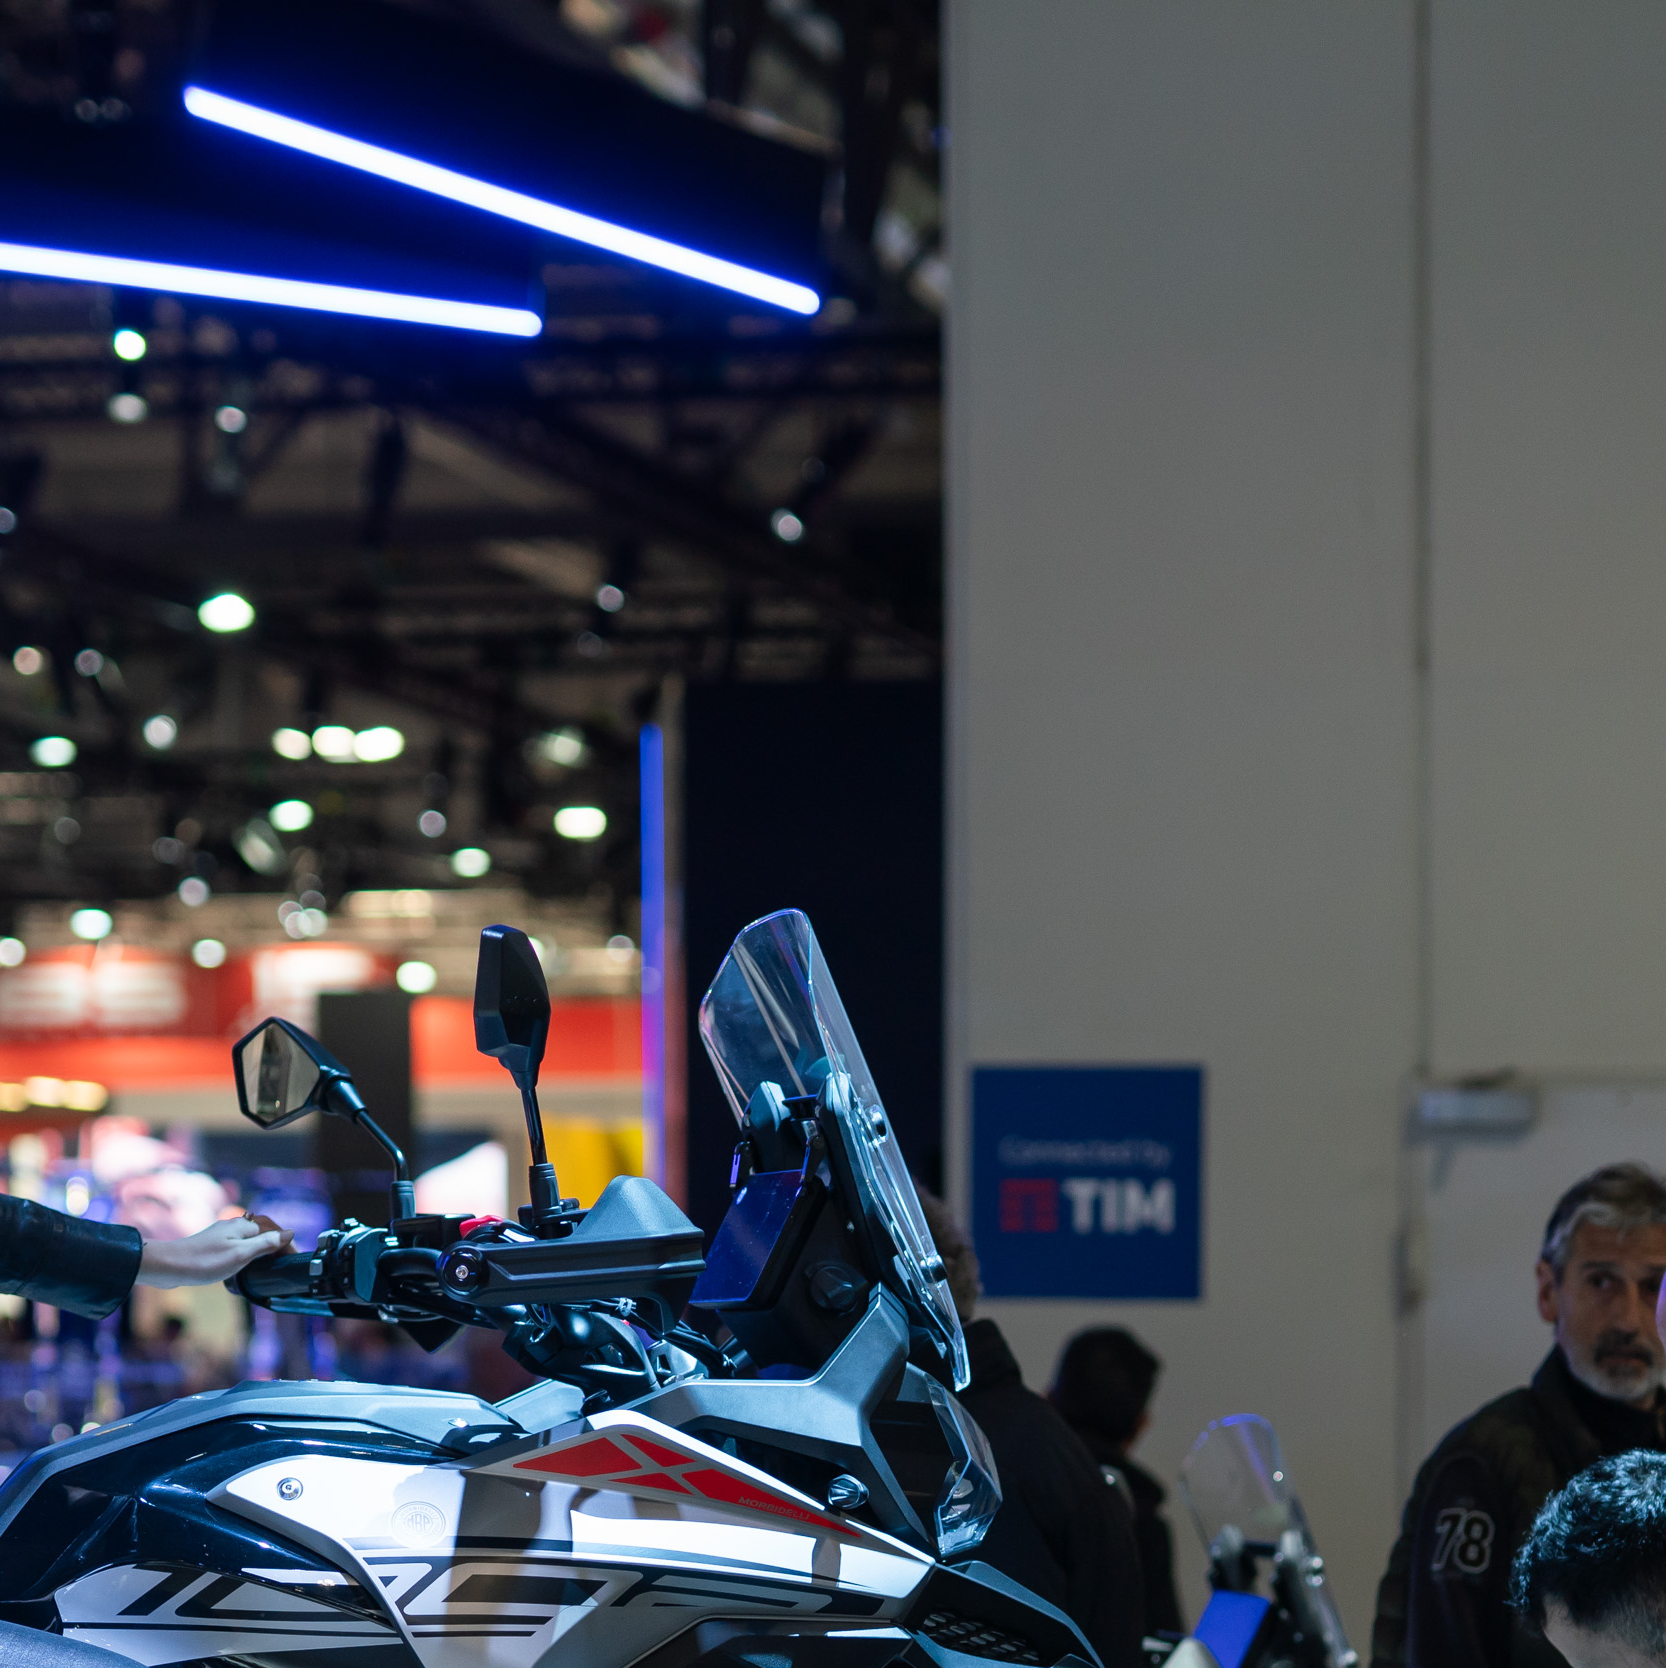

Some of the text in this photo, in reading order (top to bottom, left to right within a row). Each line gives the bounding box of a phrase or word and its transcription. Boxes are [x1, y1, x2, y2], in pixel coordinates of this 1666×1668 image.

[1064, 1178, 1175, 1233] TIM
[737, 1496, 811, 1521] MORBIDELLI
[1431, 1507, 1495, 1574] 78
